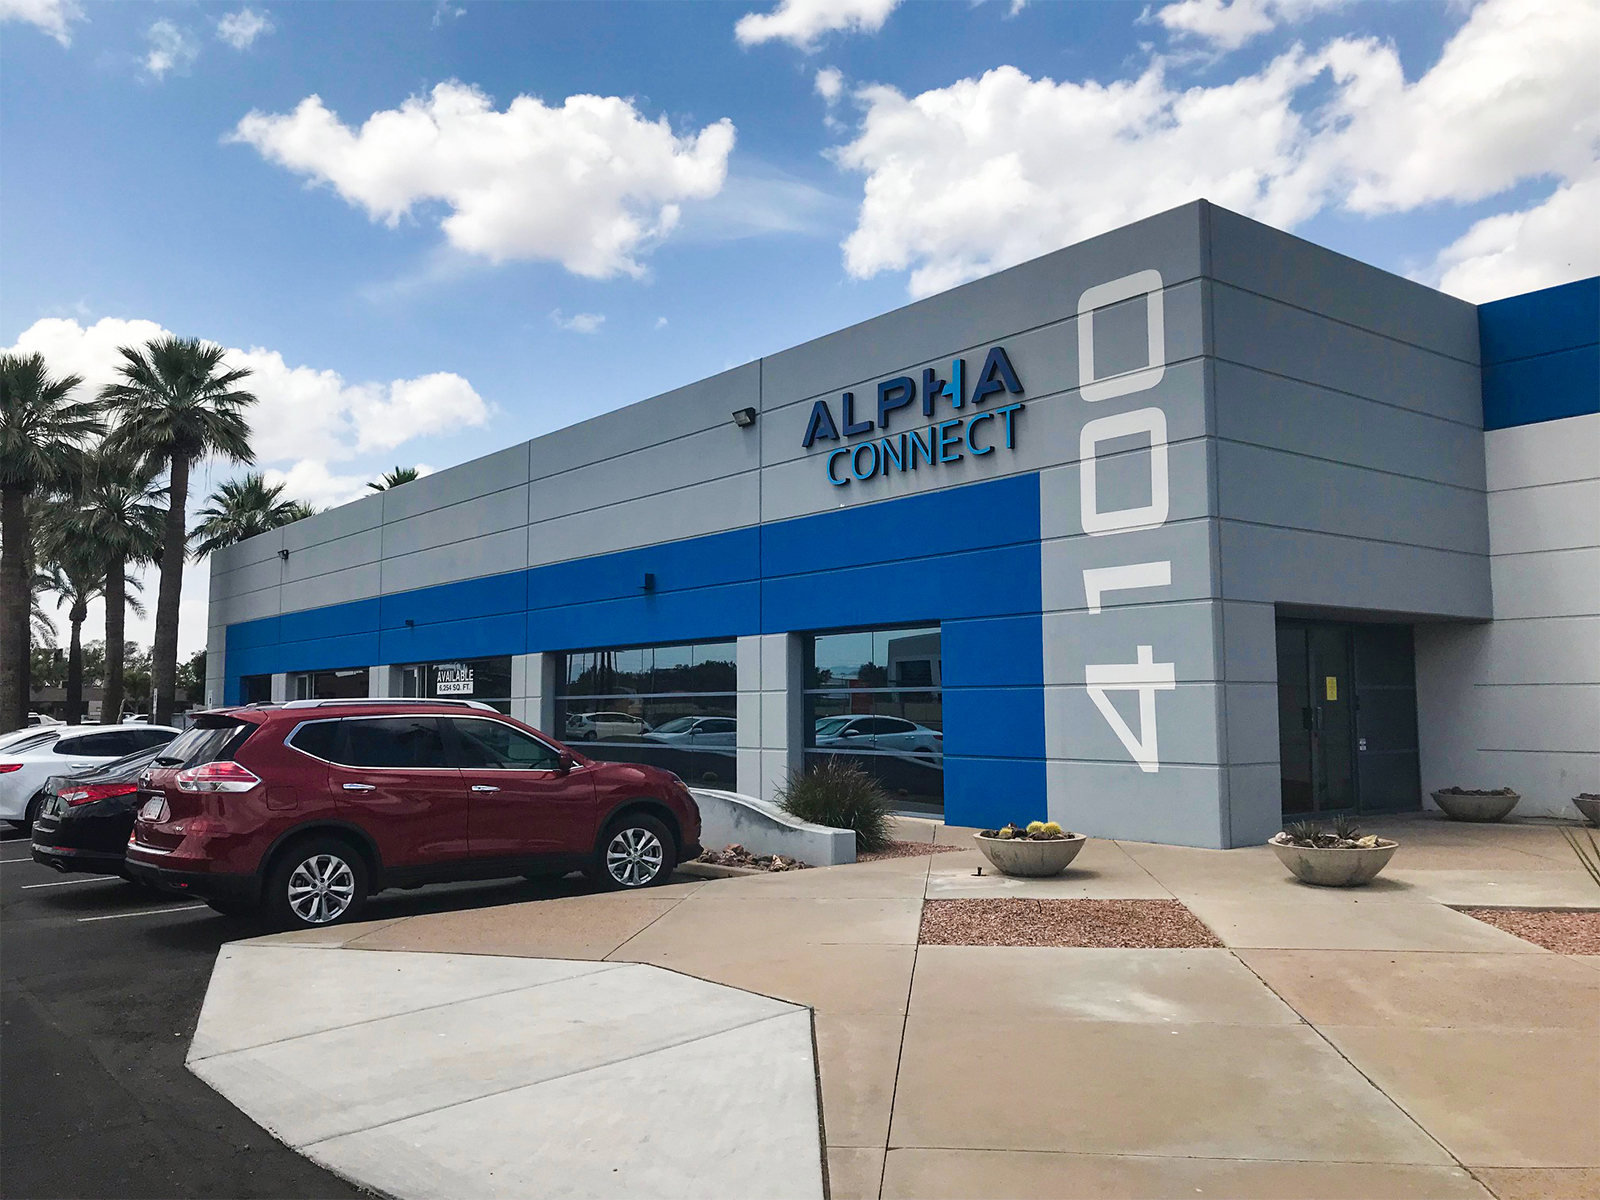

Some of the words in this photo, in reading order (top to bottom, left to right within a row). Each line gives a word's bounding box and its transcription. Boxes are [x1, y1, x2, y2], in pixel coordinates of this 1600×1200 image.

[802, 346, 1024, 448] ALPHA
[826, 403, 1025, 486] CONNECT
[1078, 269, 1176, 773] 4100
[437, 669, 473, 682] AVAILABLE
[463, 683, 471, 691] FT.
